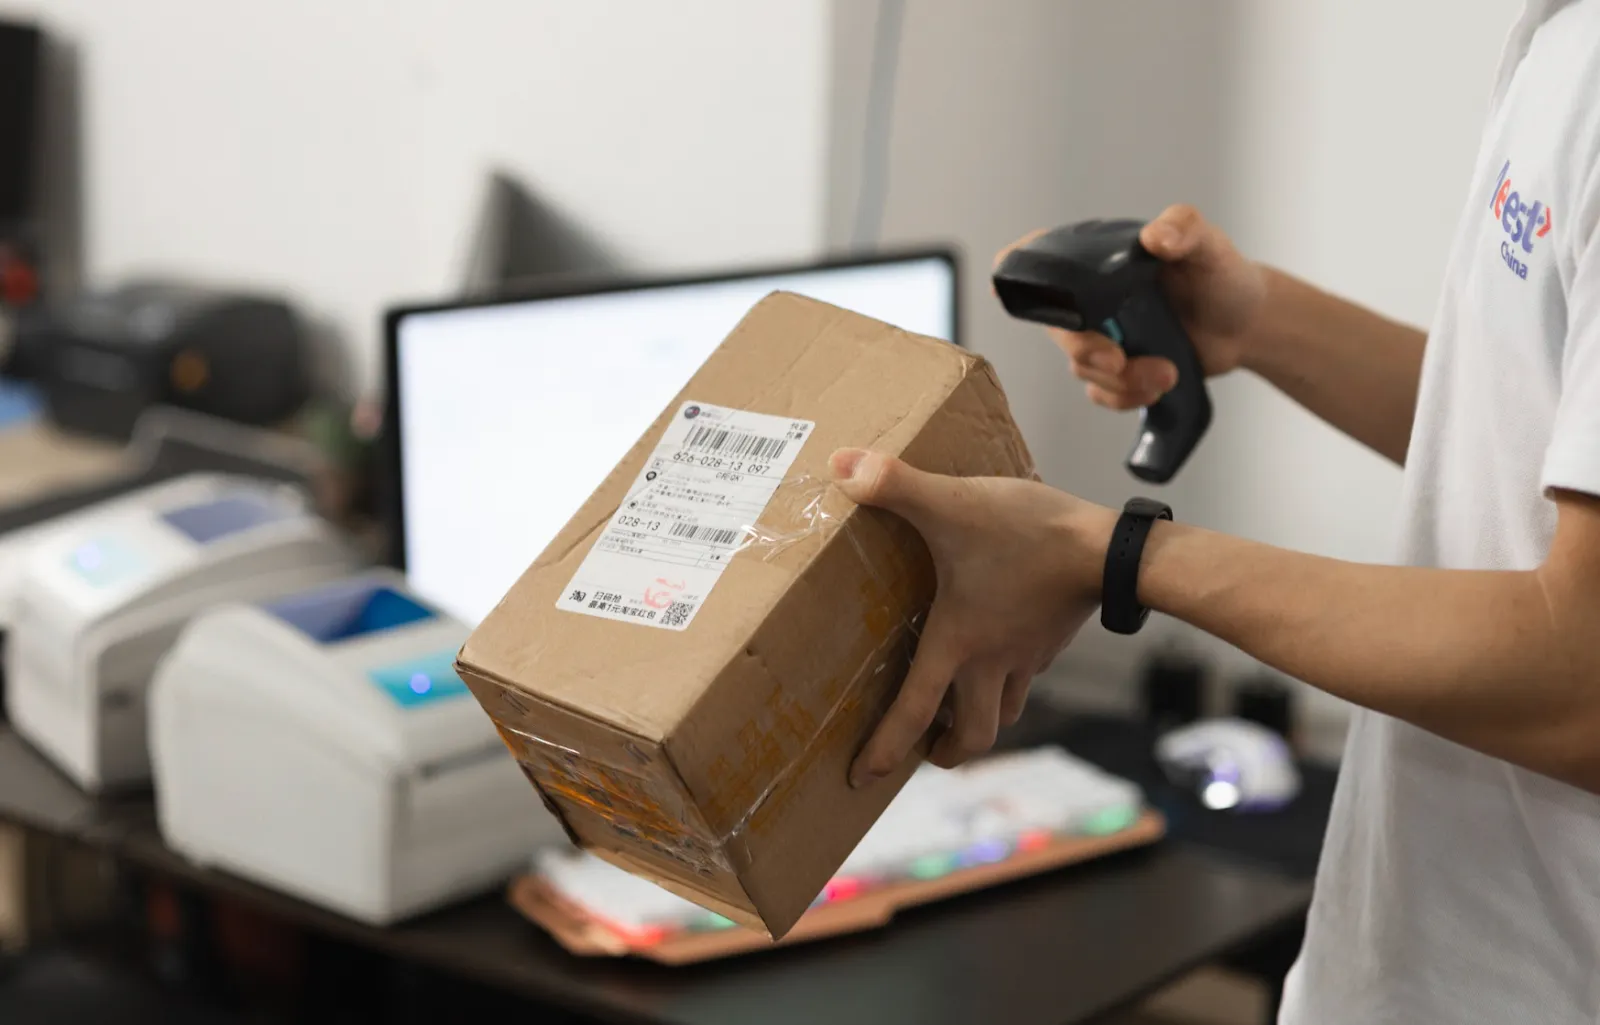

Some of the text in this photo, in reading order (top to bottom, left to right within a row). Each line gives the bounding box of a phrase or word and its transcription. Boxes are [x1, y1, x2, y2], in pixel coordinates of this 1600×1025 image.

[1500, 240, 1528, 281] China
[673, 451, 743, 471] 626-028-13
[747, 464, 770, 476] 097
[617, 515, 661, 532] 028-13
[587, 600, 657, 620] 最高1元淘宝红包
